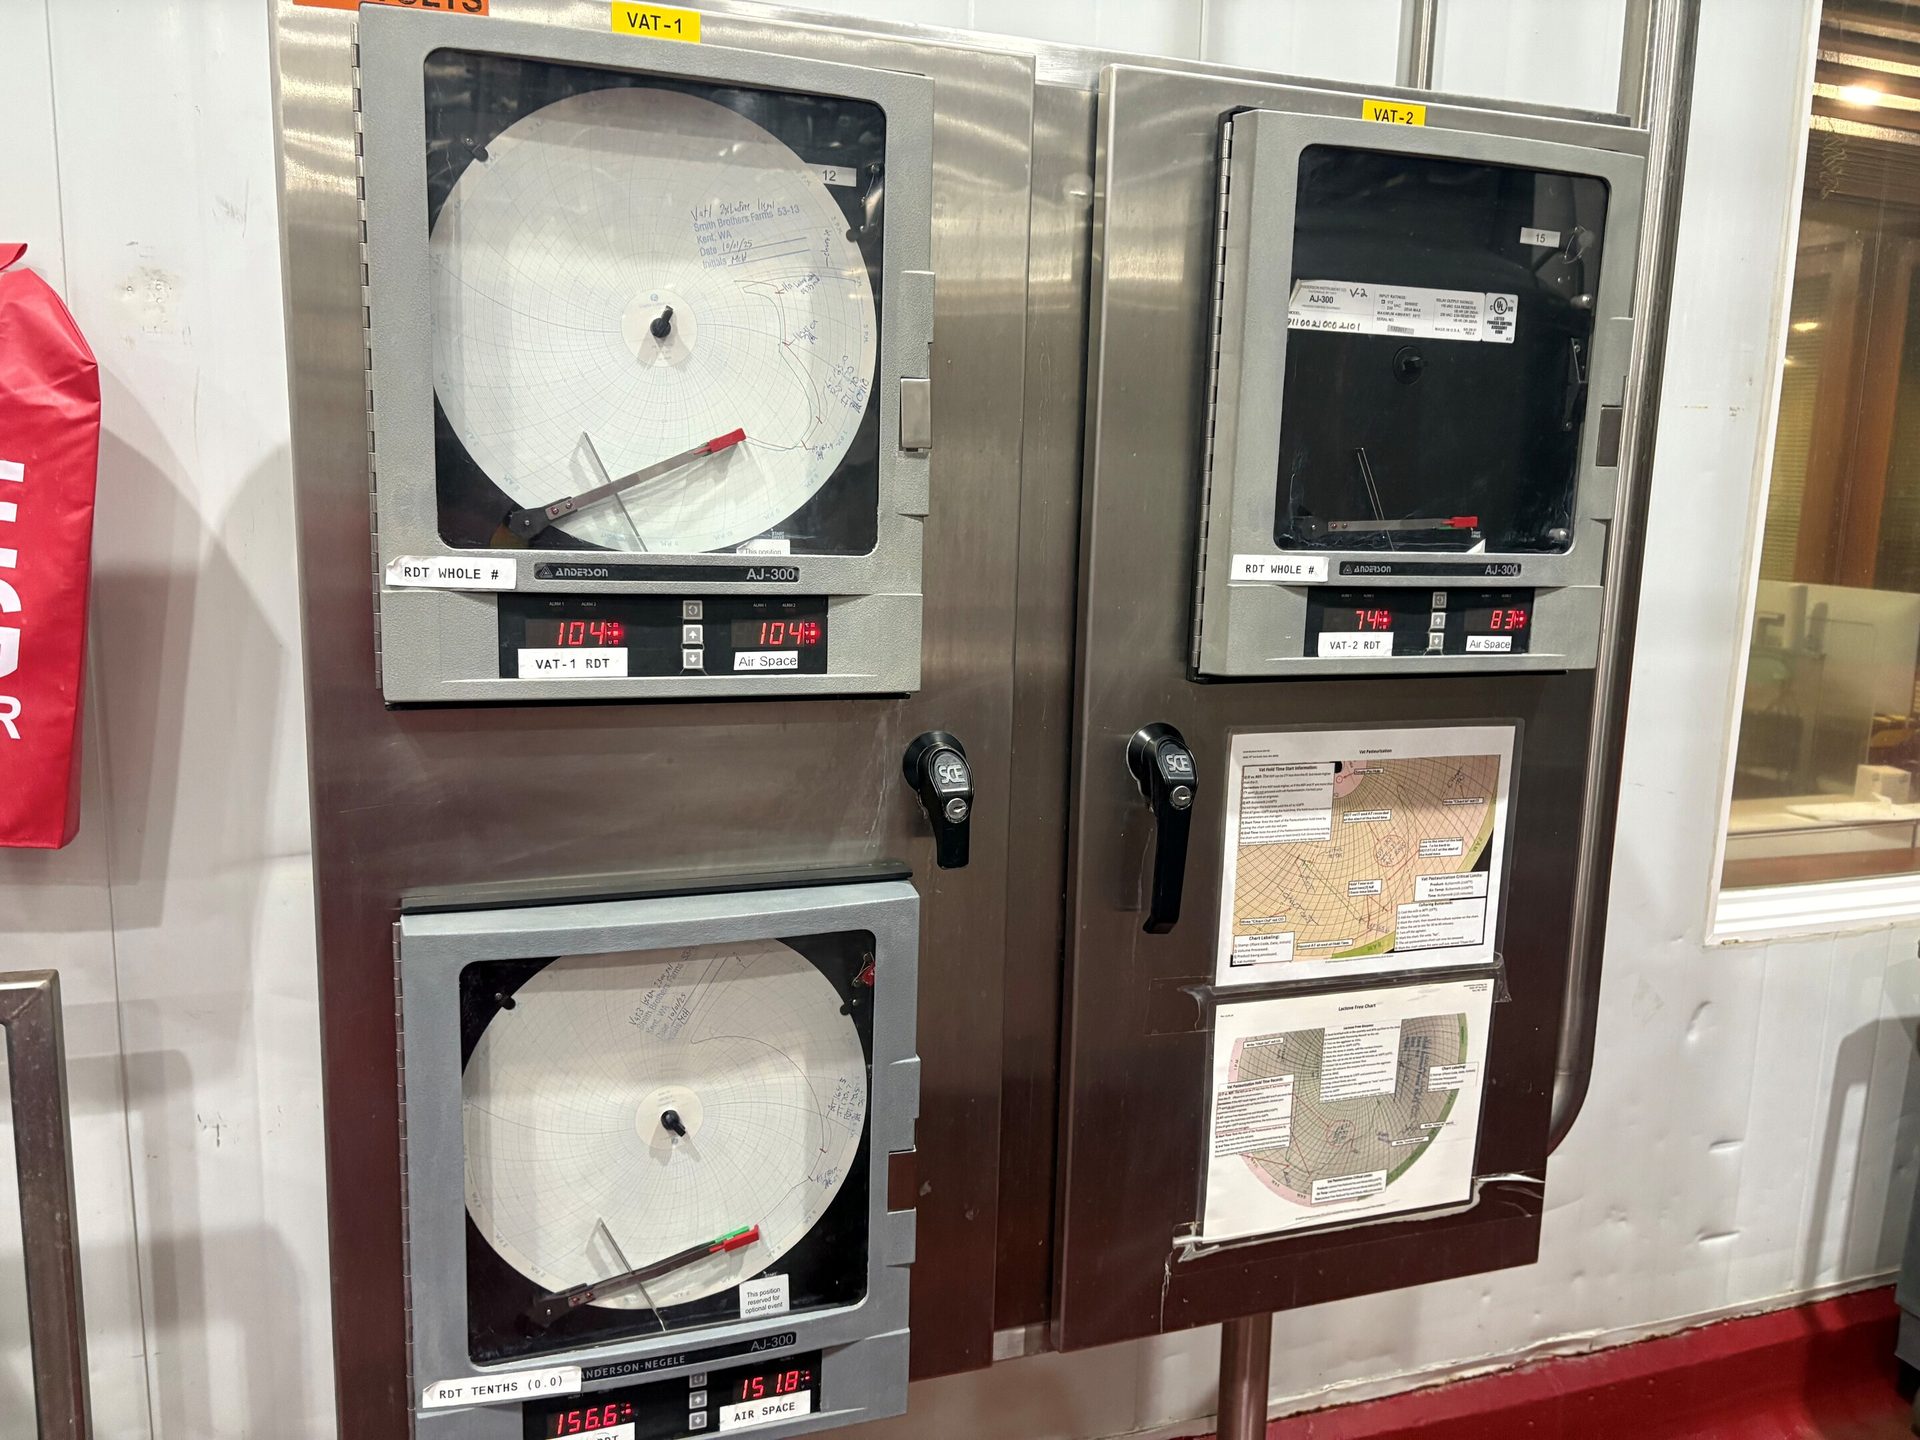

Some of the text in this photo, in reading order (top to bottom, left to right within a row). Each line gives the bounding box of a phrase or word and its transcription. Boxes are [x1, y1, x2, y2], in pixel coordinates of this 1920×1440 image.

[626, 11, 683, 34] VAT-1
[1374, 108, 1414, 125] VAT-2
[822, 169, 836, 182] 12
[693, 204, 800, 232] Smith Brothers Farms 53-13
[718, 230, 732, 241] WA
[1535, 232, 1546, 243] 15
[699, 246, 718, 257] Date
[1309, 295, 1334, 303] AJ-300
[1349, 288, 1368, 298] V-2
[404, 566, 500, 581] RDT WHOLE #
[555, 567, 609, 577] ANDERSON
[746, 568, 795, 581] AJ-300
[1245, 564, 1315, 574] RDT WHOLE #
[1354, 564, 1391, 573] ANDERSON
[1485, 564, 1519, 576] AJ-300
[1356, 611, 1378, 630] 74
[1490, 611, 1513, 630] 83
[558, 622, 605, 646] 104
[760, 622, 803, 646] 104
[1330, 641, 1381, 650] VAT-2 RDT
[1469, 640, 1511, 650] Air Space
[535, 658, 610, 669] VAT-1 RDT
[739, 656, 797, 670] Air Space
[1165, 754, 1191, 773] SCE
[938, 764, 966, 784] SCE
[759, 1287, 781, 1297] position
[744, 1301, 783, 1315] optional event
[747, 1297, 771, 1306] reserved
[750, 1333, 794, 1352] AJ-300
[439, 1374, 564, 1399] RDT TENTHS (0.0)
[742, 1370, 799, 1400] 151.8
[556, 1404, 617, 1435] 156.6
[734, 1402, 795, 1423] AIR SPACE
